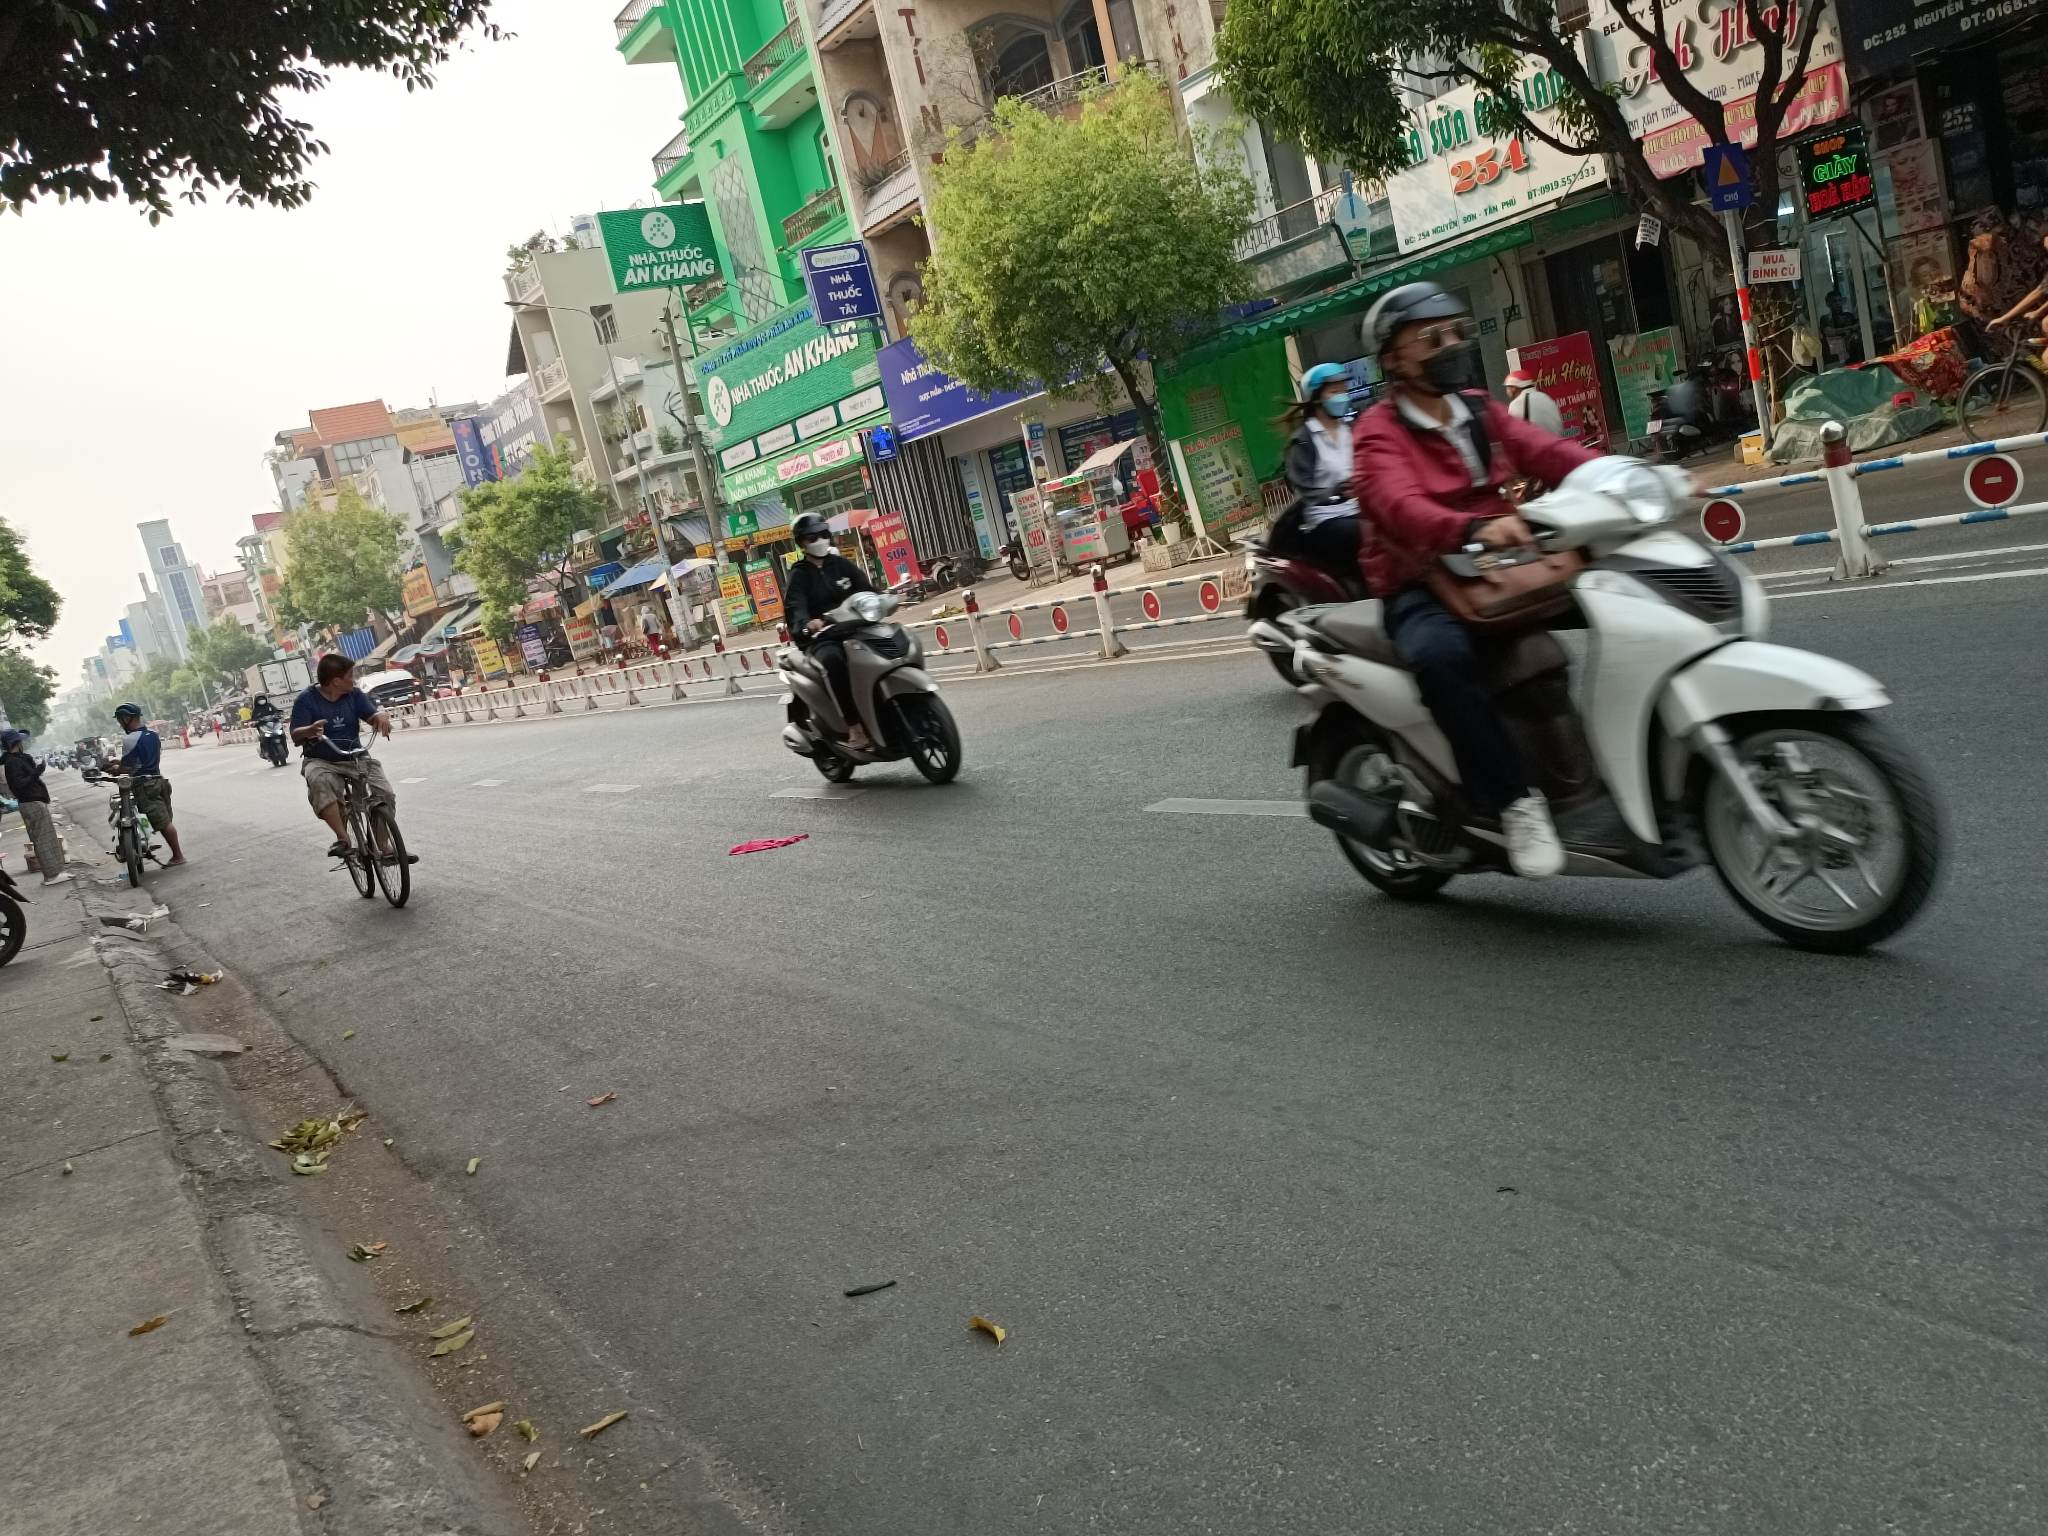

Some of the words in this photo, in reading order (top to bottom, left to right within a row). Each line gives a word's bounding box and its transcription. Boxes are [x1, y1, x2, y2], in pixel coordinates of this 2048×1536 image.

[1450, 138, 1529, 194] 254
[1813, 154, 1857, 182] GIÀY
[629, 250, 658, 267] NHÀ
[658, 244, 703, 262] THUỐC
[1763, 254, 1786, 265] MUA
[624, 267, 650, 286] AN
[653, 259, 715, 282] KHANG
[830, 270, 853, 285] NHÀ
[828, 284, 863, 301] THUỐC
[784, 347, 805, 381] AN
